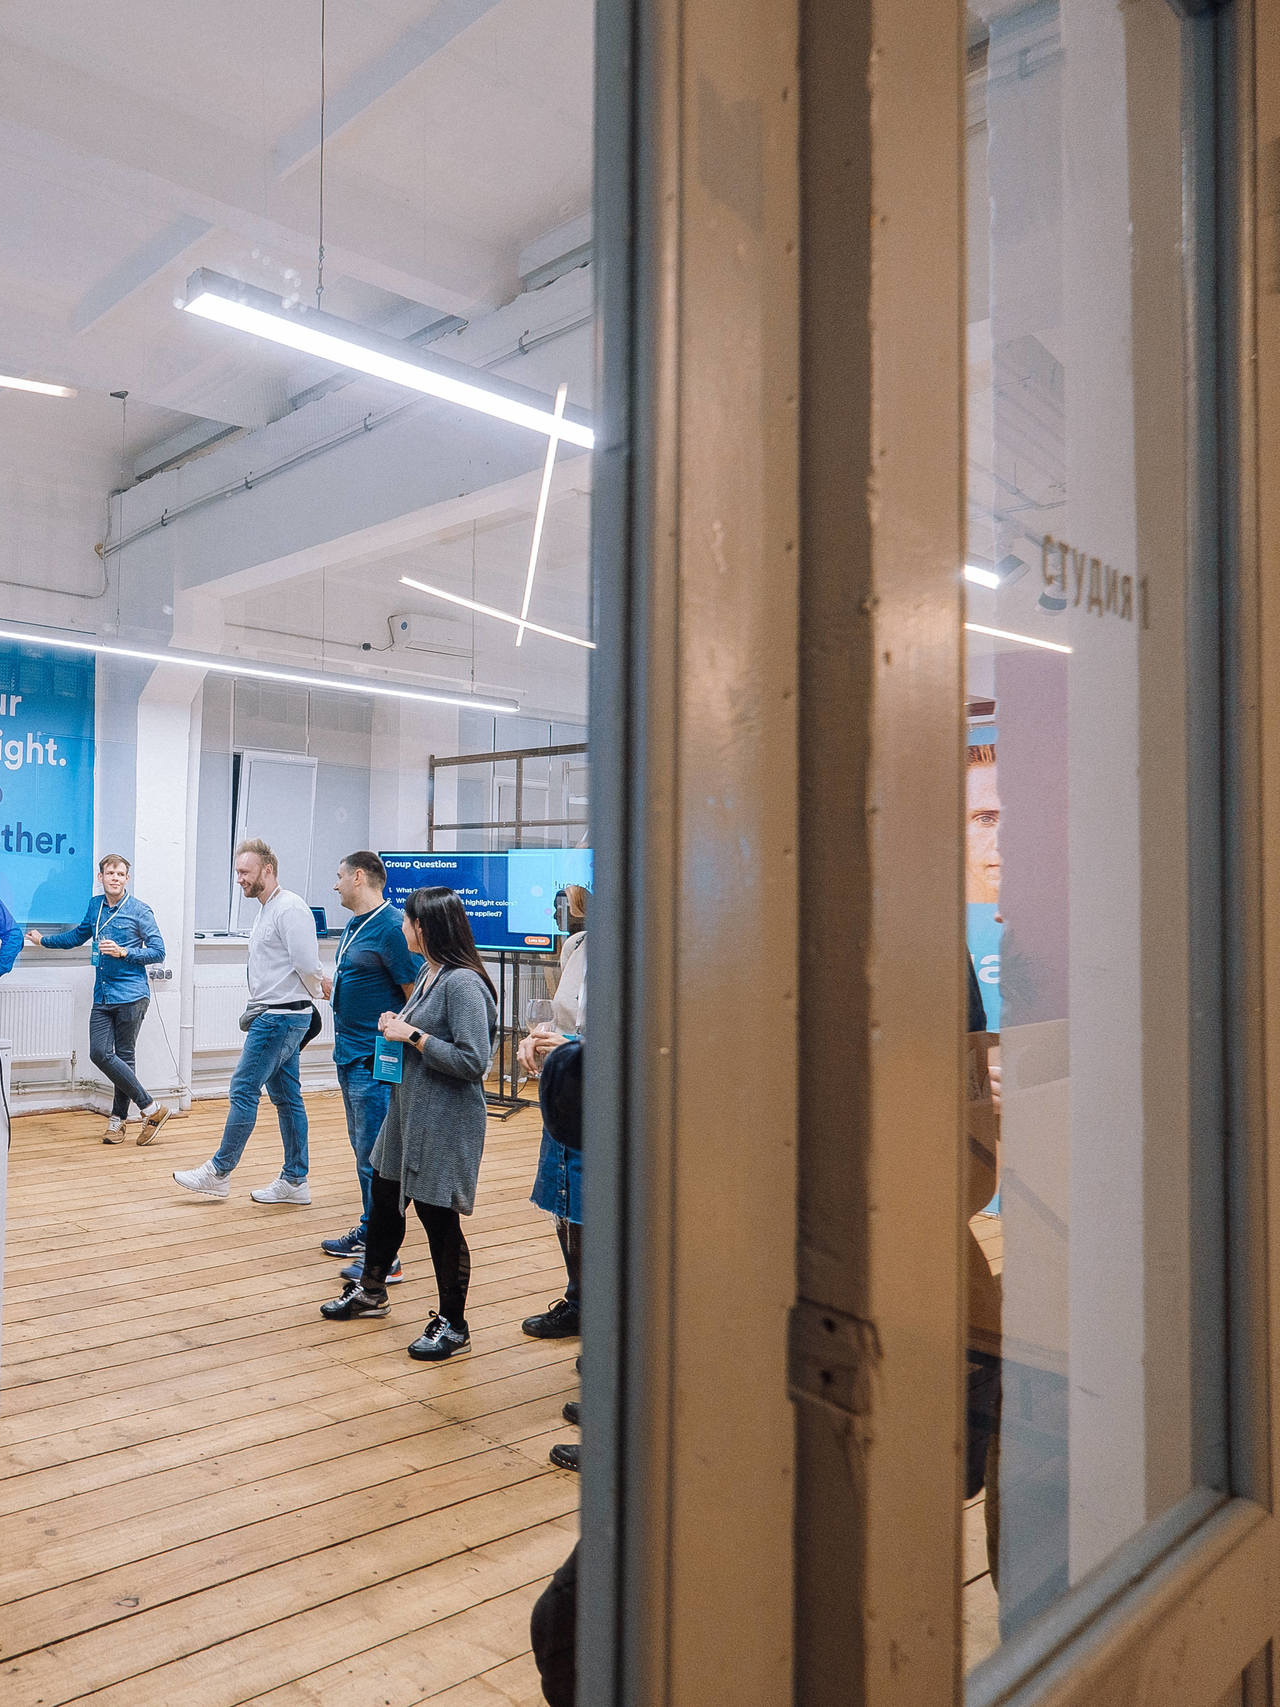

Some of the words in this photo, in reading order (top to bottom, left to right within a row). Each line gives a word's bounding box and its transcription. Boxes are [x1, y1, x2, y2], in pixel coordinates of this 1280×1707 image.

[1041, 534, 1134, 622] СТУДИЯ
[385, 860, 411, 869] Group
[413, 860, 457, 869] Questions
[465, 899, 495, 907] highlight
